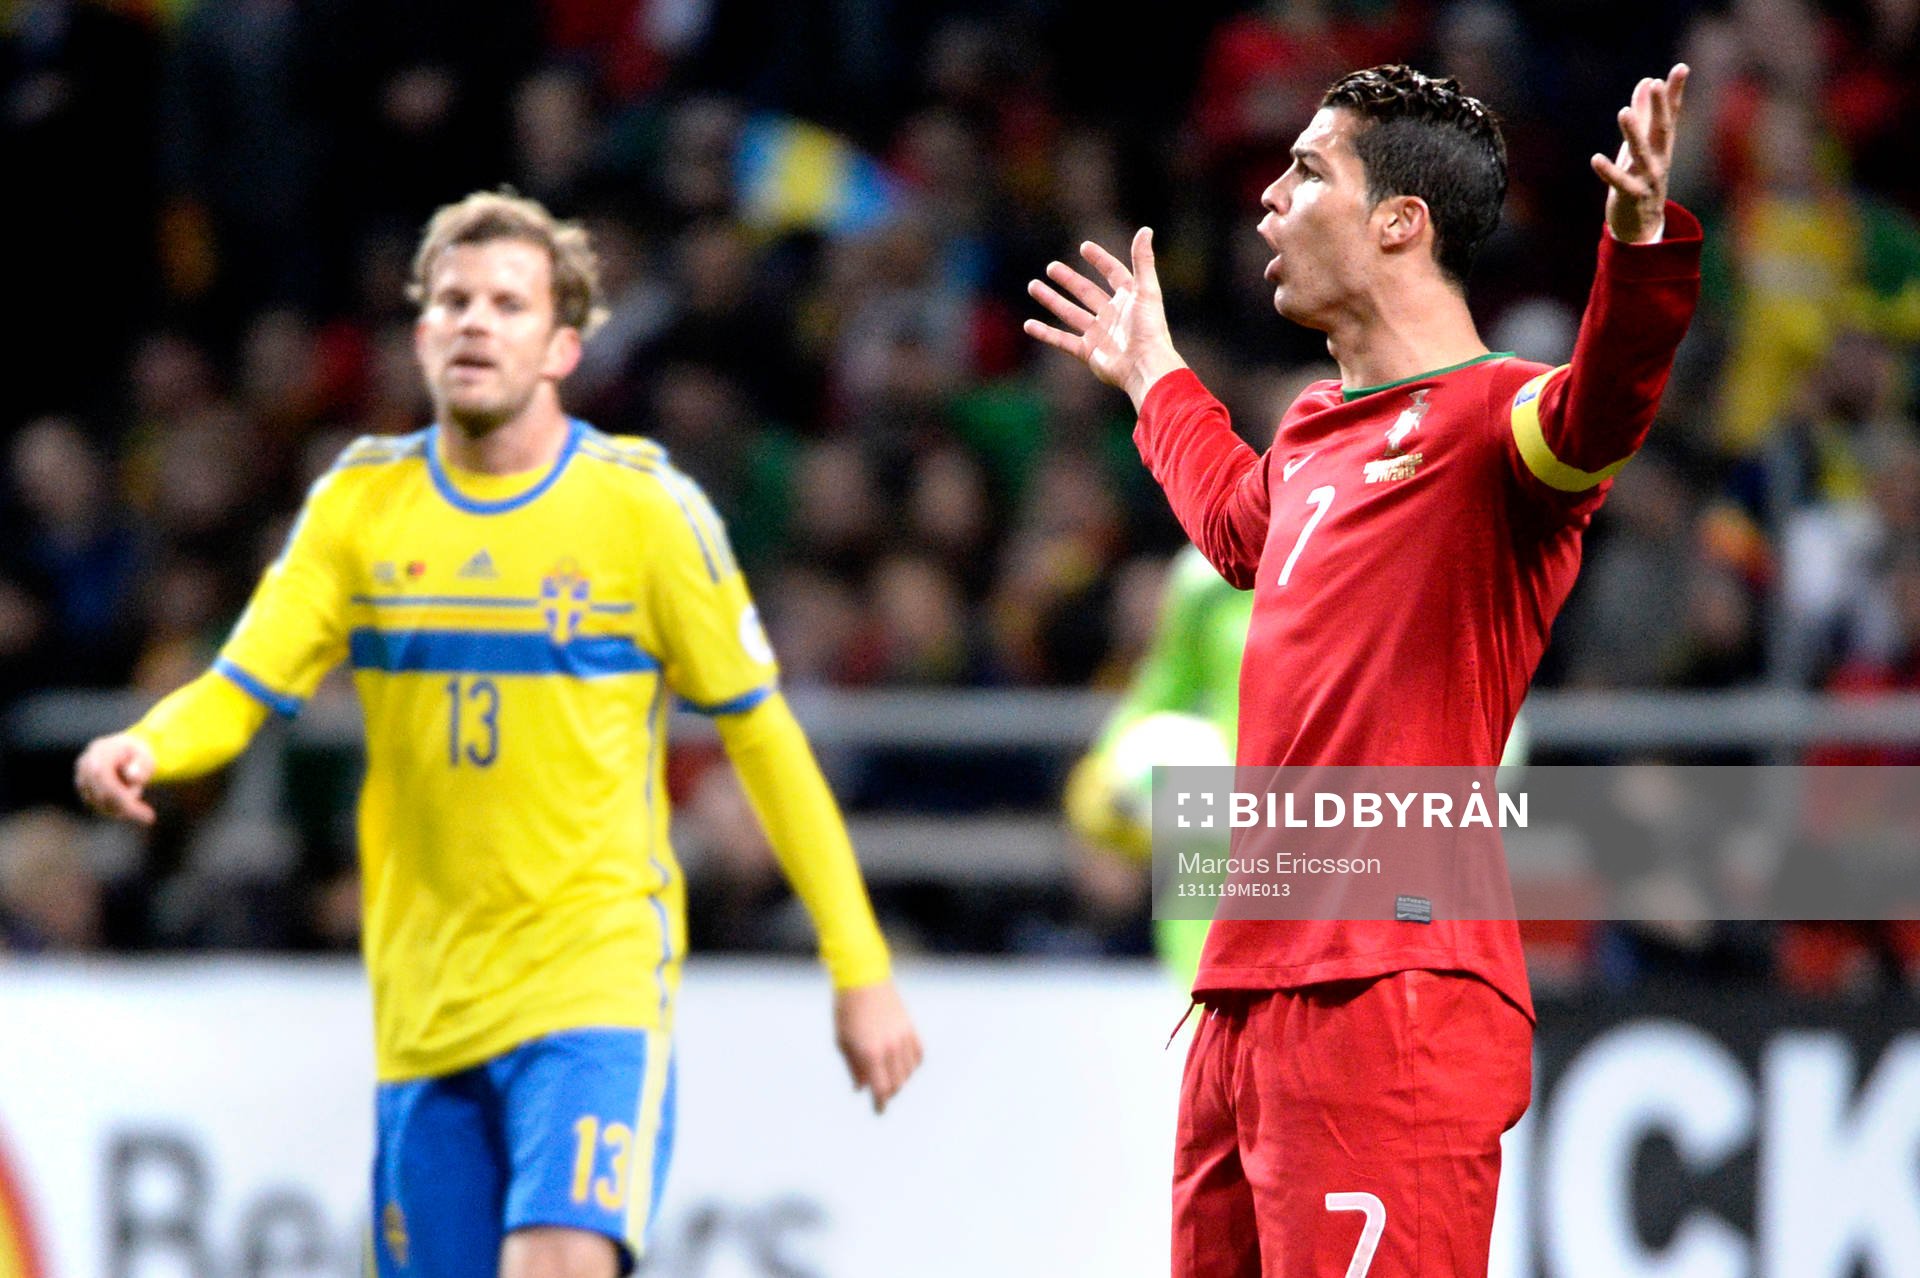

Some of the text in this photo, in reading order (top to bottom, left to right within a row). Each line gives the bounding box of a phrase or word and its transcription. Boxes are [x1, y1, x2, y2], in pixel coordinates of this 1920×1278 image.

[1278, 485, 1336, 587] 7
[446, 679, 500, 769] 13
[573, 1115, 634, 1209] 13
[1325, 1191, 1387, 1278] 7
